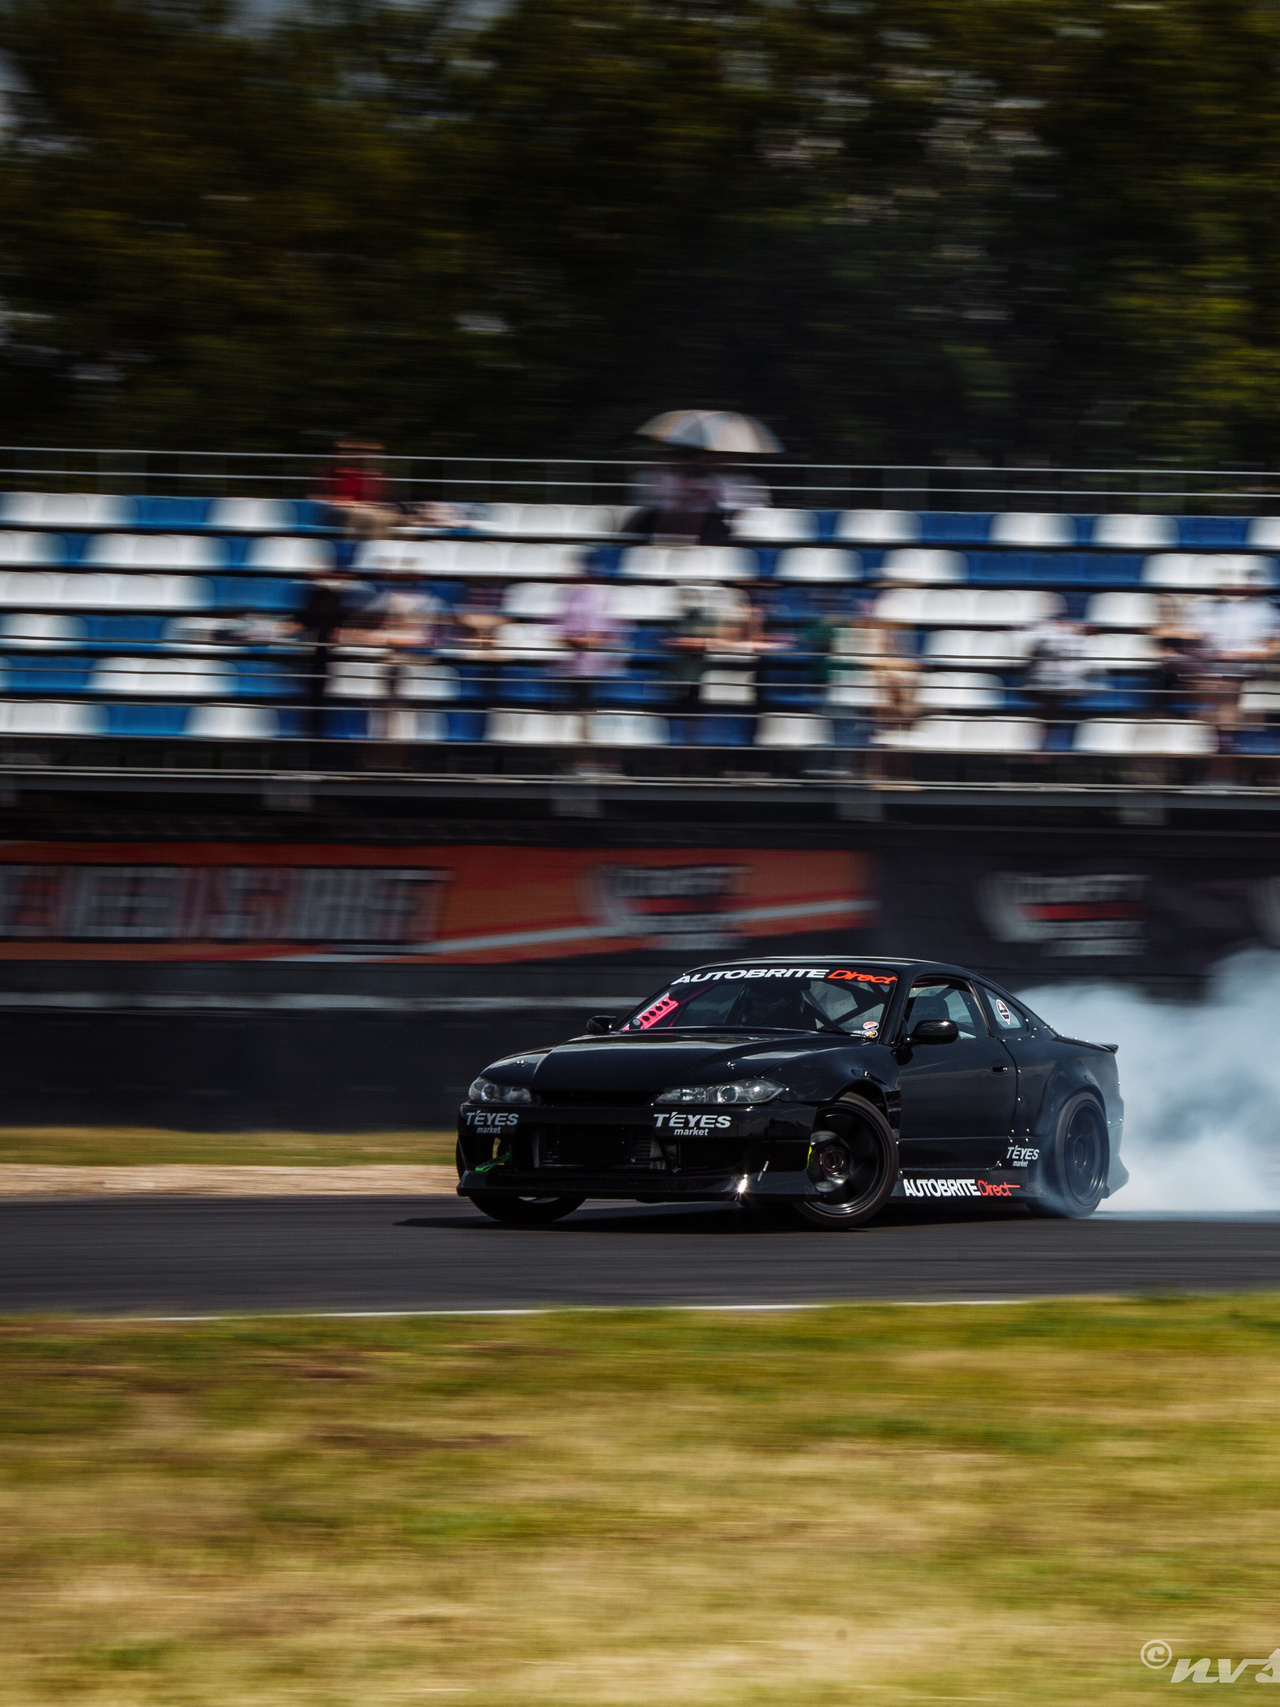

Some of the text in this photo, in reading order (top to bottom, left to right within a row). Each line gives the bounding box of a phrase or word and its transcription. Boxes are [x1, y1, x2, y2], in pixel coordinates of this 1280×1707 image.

[671, 968, 898, 986] AUTOBRITE Direct
[476, 1125, 501, 1134] market
[673, 1127, 709, 1136] market
[903, 1178, 1020, 1197] AUTOBRITE Direct
